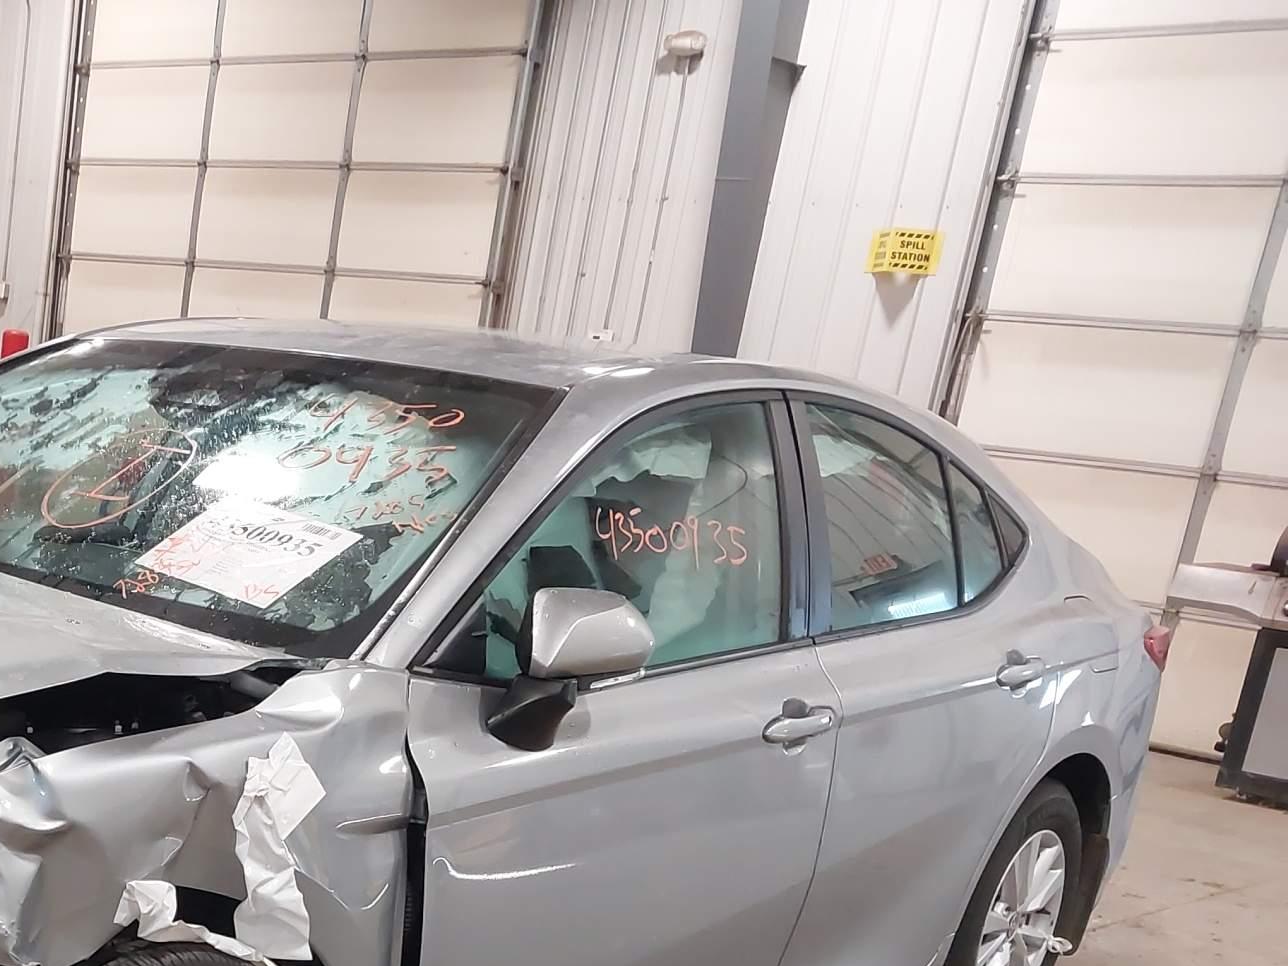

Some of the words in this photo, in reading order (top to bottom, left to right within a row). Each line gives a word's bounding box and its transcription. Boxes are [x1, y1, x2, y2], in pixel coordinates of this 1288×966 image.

[890, 251, 930, 263] STATION
[900, 240, 926, 250] SPILL
[278, 445, 457, 489] 0935
[595, 506, 749, 568] 43500935
